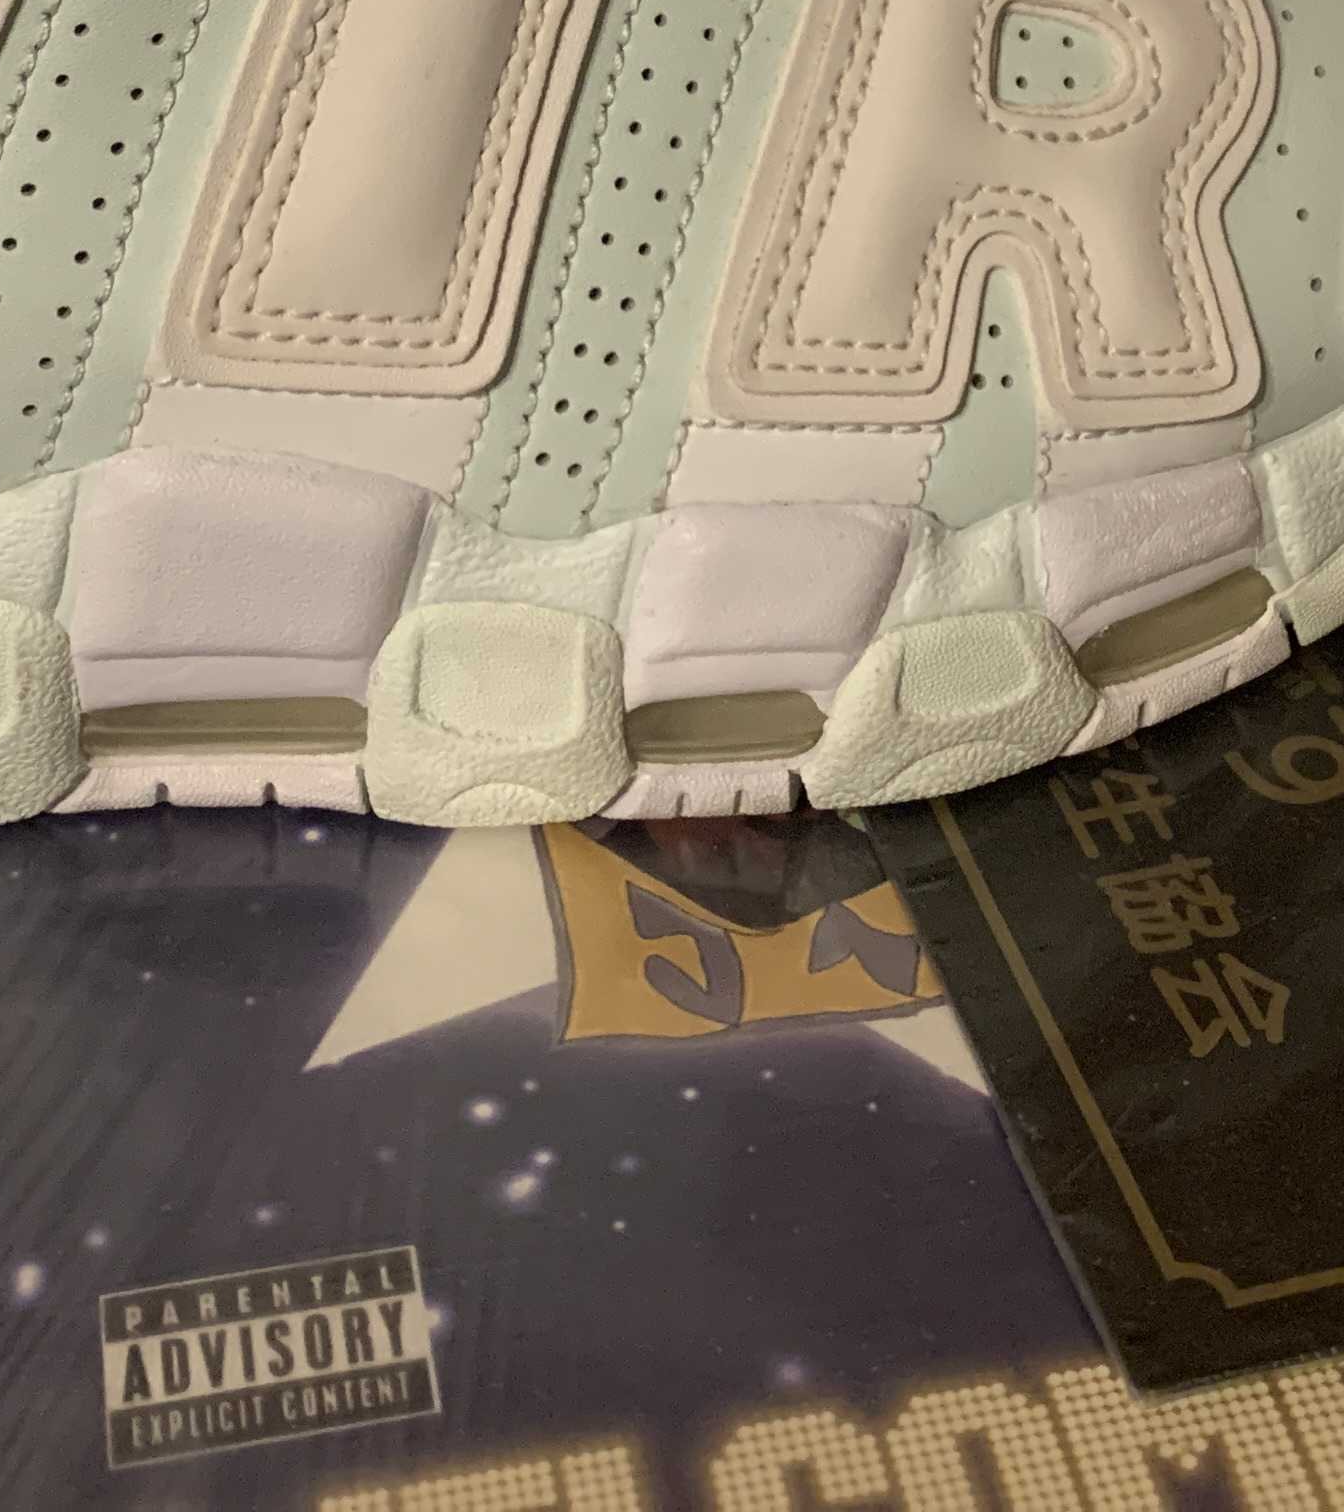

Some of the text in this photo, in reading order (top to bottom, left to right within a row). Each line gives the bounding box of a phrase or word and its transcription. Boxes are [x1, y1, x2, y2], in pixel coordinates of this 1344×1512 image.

[1047, 736, 1292, 1059] 生協会
[123, 1264, 400, 1334] PARENTAL
[121, 1300, 408, 1405] ADVISORY
[128, 1372, 415, 1448] EXPLICIT CONTENT
